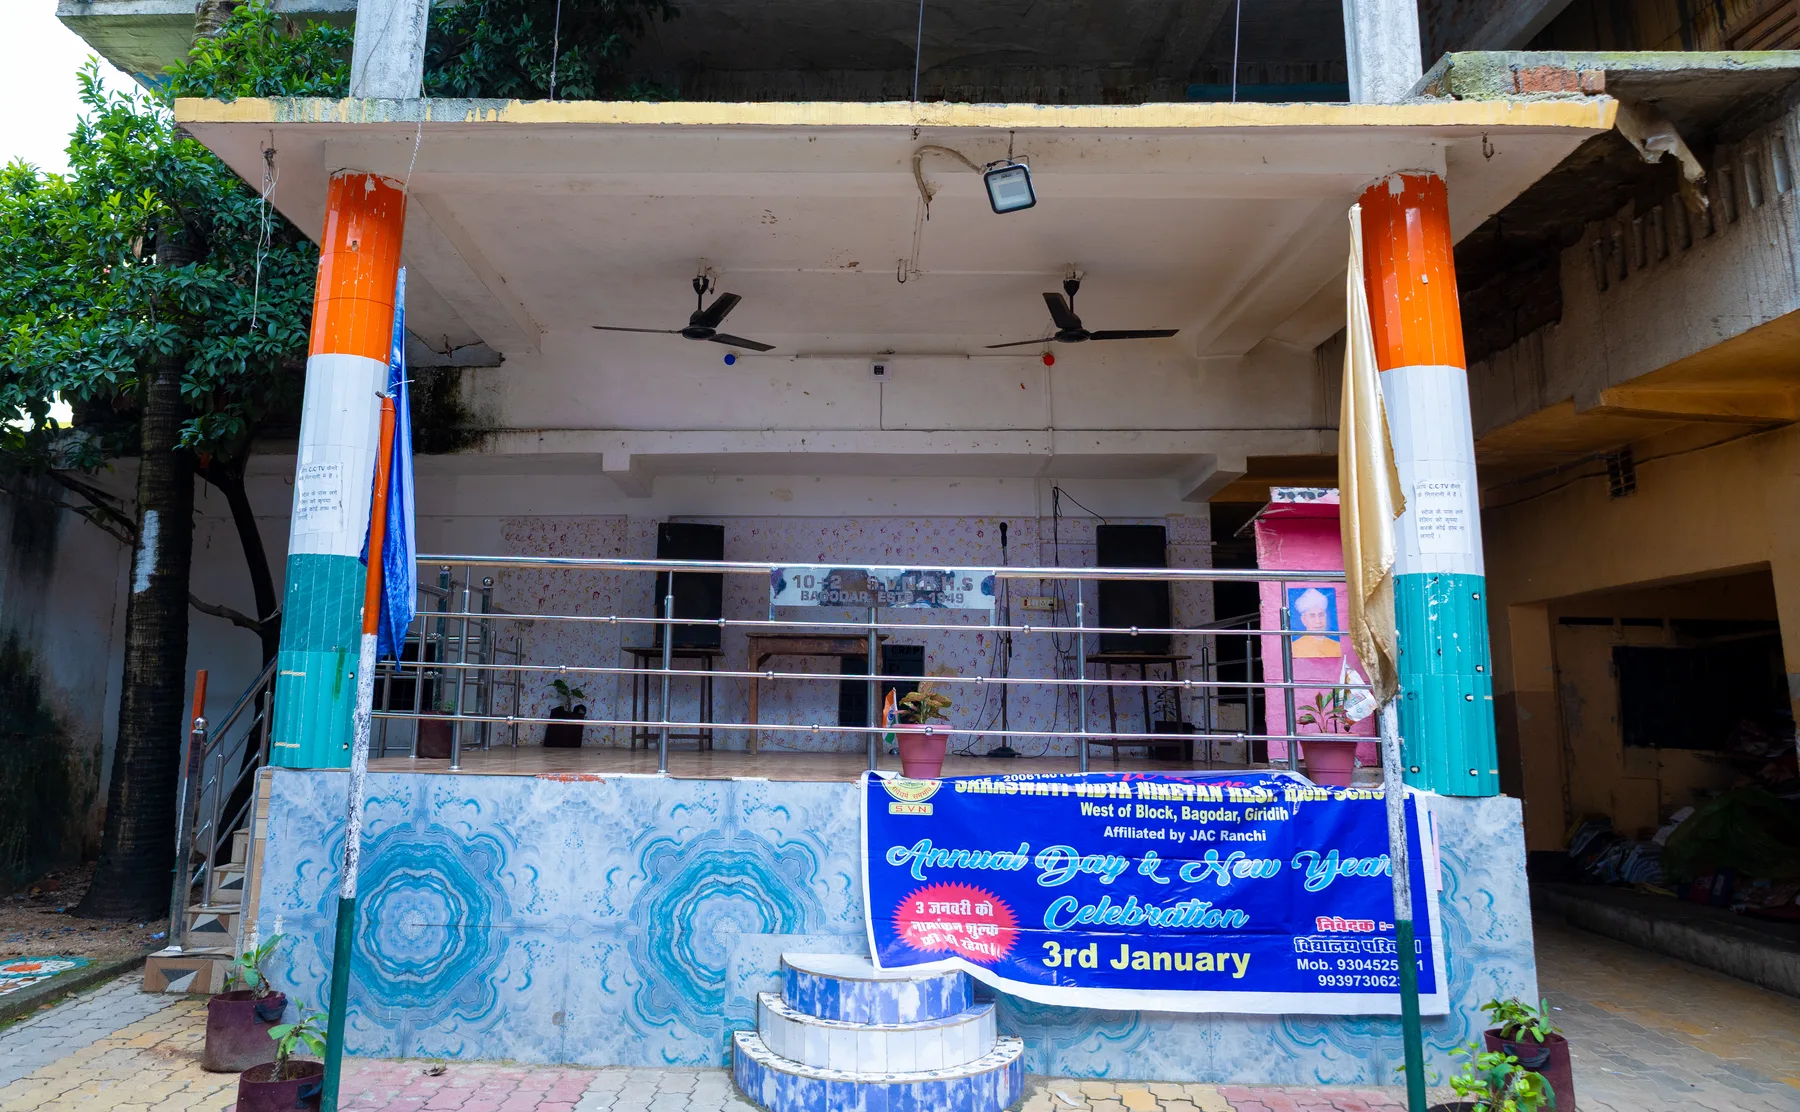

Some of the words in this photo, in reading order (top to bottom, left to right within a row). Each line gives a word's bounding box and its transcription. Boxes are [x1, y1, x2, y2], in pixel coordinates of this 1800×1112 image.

[792, 574, 842, 590] 10+2
[1136, 781, 1223, 803] NIKETAN
[1080, 802, 1114, 818] West
[1118, 804, 1132, 818] of
[1135, 804, 1178, 822] Block,
[1181, 806, 1241, 824] Bagodar,
[1244, 806, 1289, 821] Giridih
[1103, 825, 1165, 840] Affiliated
[1169, 829, 1186, 843] by
[1189, 830, 1216, 841] JAC
[1220, 830, 1267, 842] Ranchi
[886, 838, 1030, 881] Annual
[1034, 844, 1131, 888] Day
[1137, 849, 1170, 884] &
[1179, 848, 1282, 887] New
[1291, 849, 1394, 892] Year
[915, 901, 925, 914] 3
[927, 899, 972, 916] जनवरी
[975, 900, 994, 917] को
[1043, 895, 1250, 931] Celebration
[1316, 916, 1375, 932] निवेदक
[1042, 941, 1098, 968] 3rd
[1110, 944, 1251, 979] January
[1296, 958, 1333, 971] Mob.
[1336, 959, 1424, 972] 93045251
